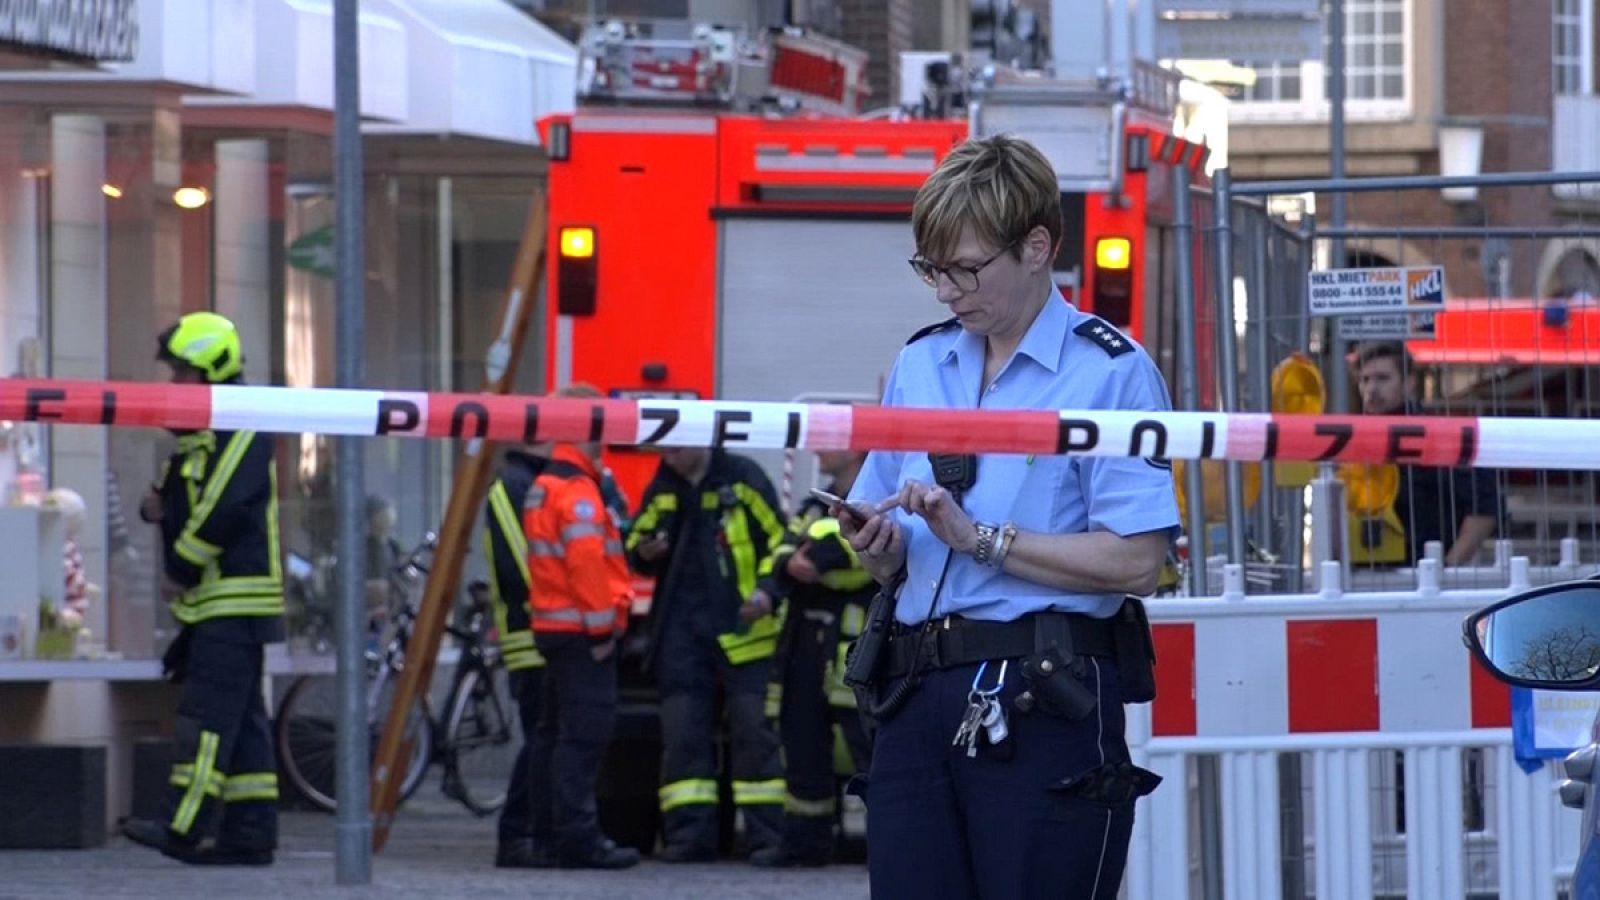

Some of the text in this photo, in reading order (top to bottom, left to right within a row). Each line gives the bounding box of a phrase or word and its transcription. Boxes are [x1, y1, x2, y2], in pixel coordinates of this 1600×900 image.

[1311, 270, 1401, 285] HKL MIETPARK
[1312, 287, 1341, 299] 0800
[1365, 285, 1386, 297] 555
[1388, 285, 1402, 296] 44
[1410, 269, 1441, 298] HKL
[375, 399, 800, 448] POLIZEI
[1057, 417, 1474, 466] POLIZEI
